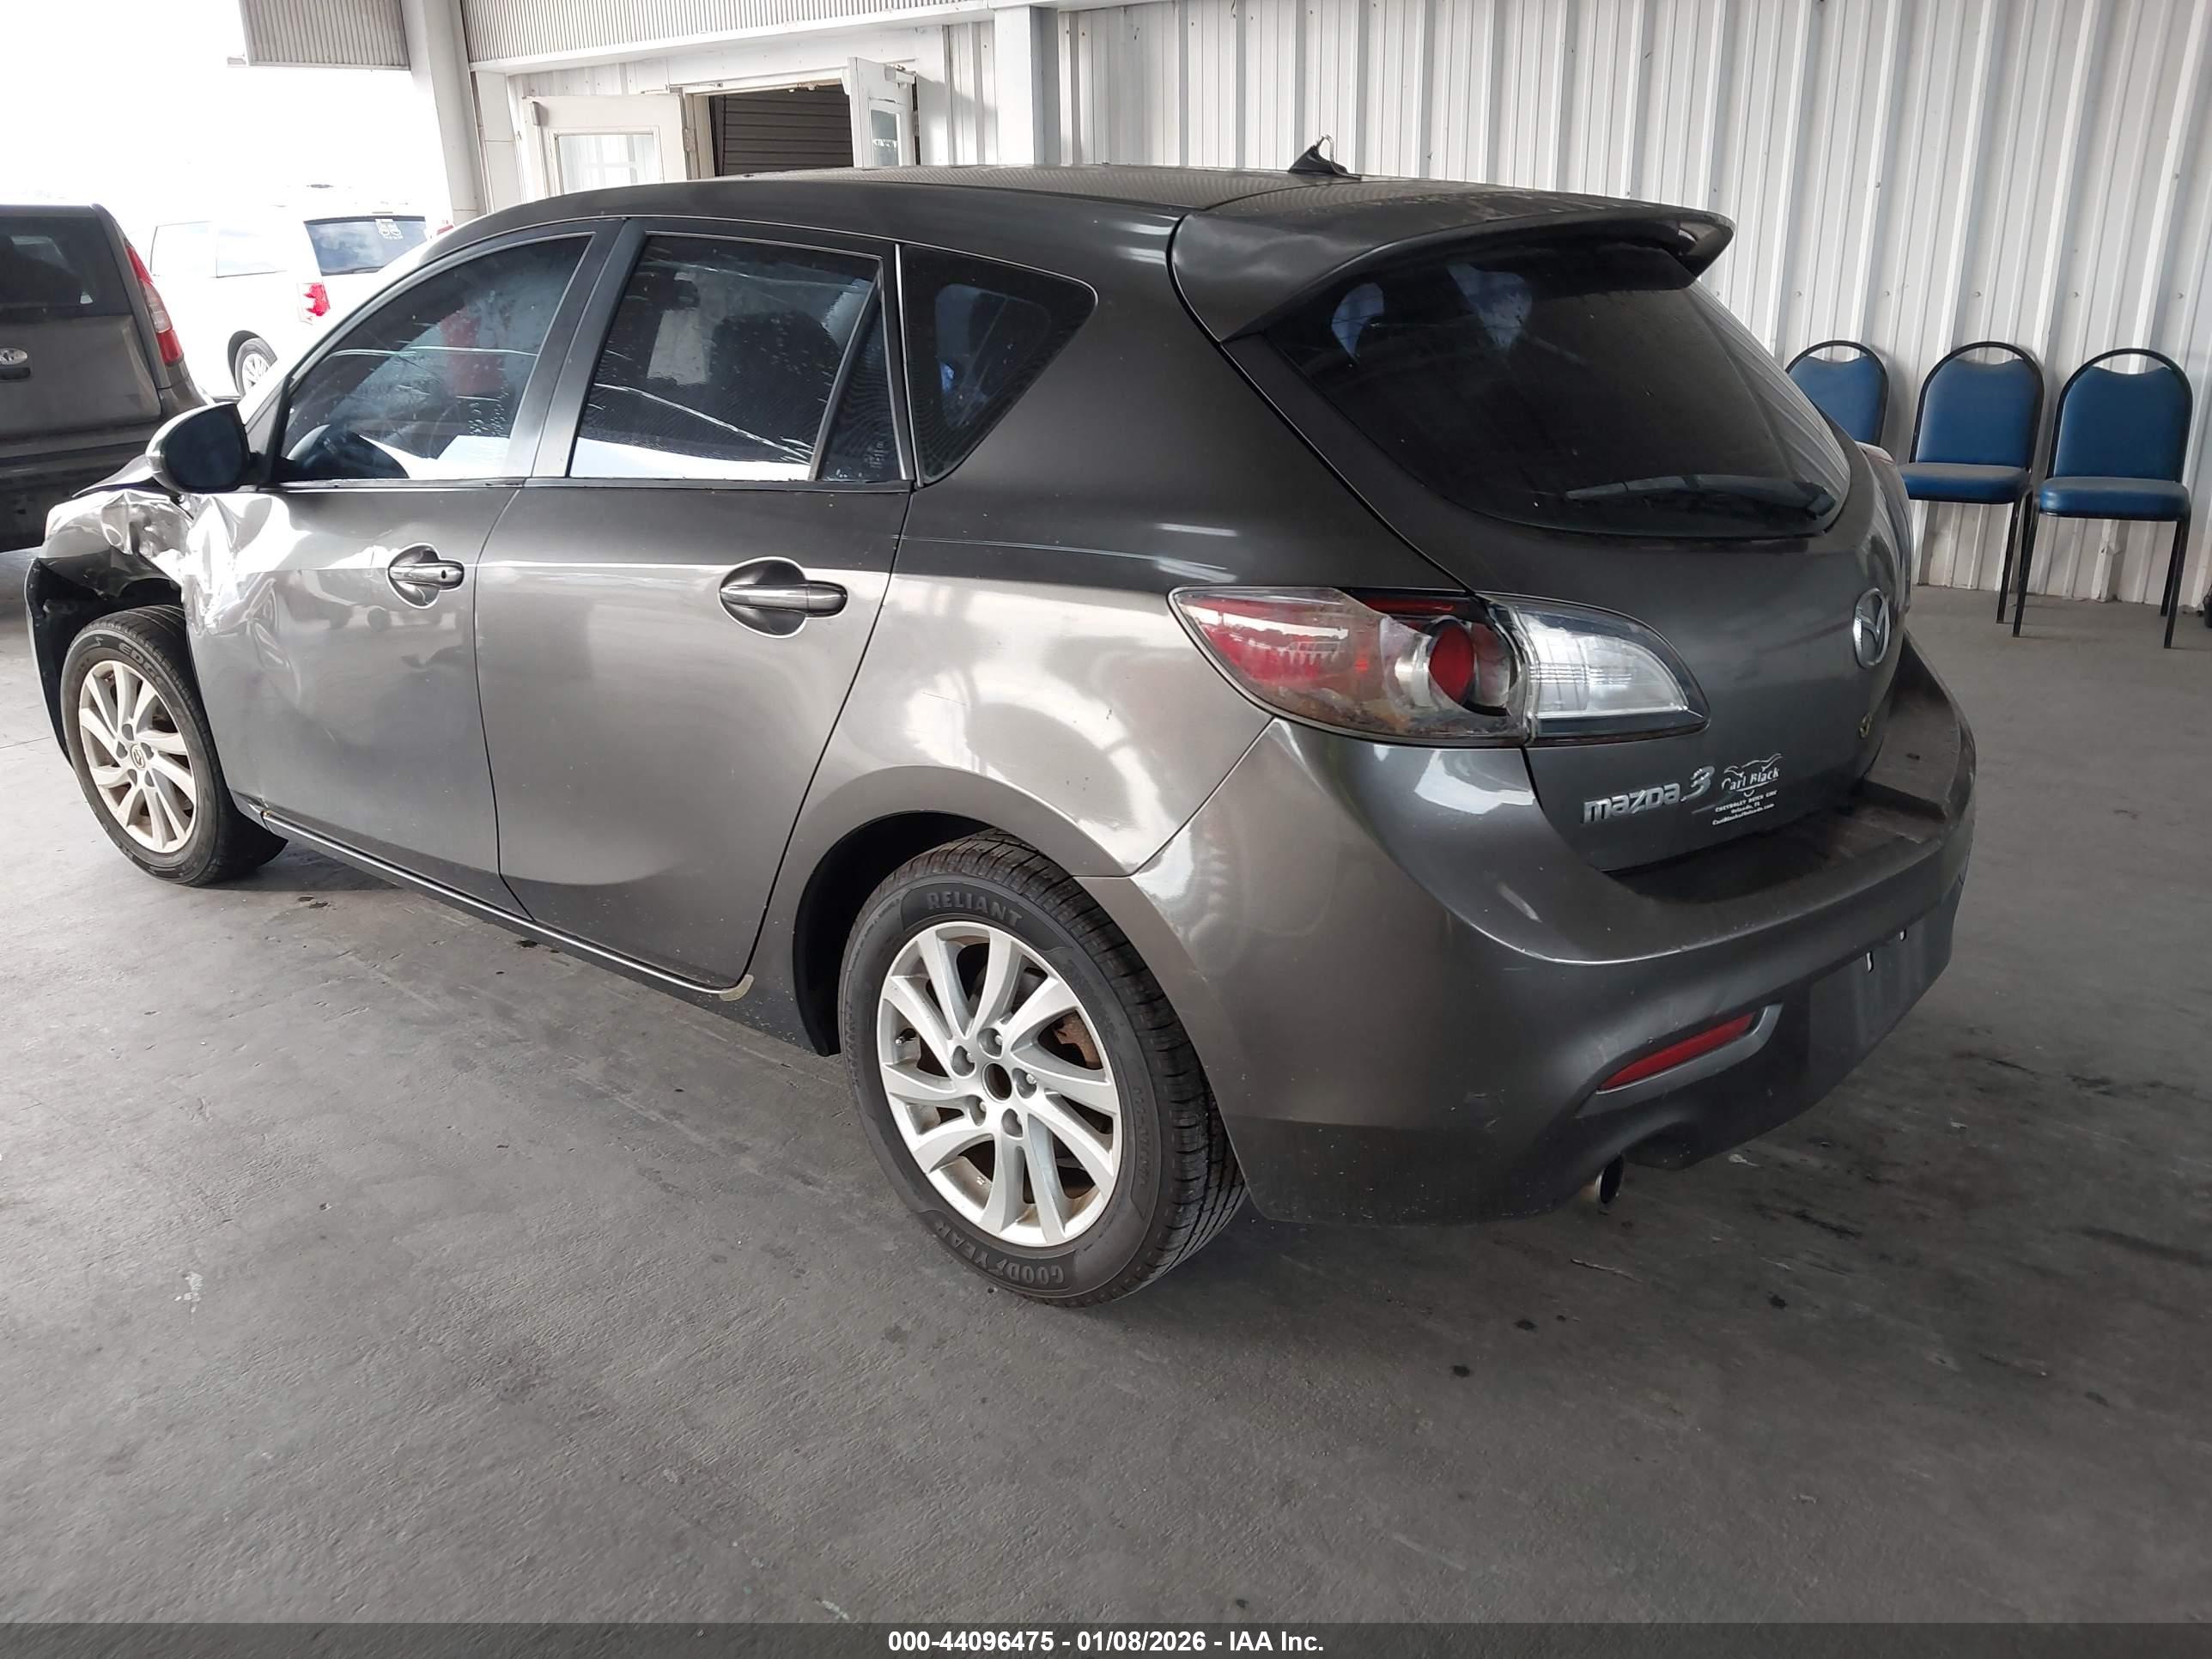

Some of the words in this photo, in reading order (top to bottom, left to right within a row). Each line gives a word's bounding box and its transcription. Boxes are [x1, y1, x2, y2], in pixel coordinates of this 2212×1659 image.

[1750, 767, 1780, 785] Black
[1582, 782, 1680, 824] mazda
[1680, 766, 1716, 802] 3
[927, 891, 1024, 927] RELIANT
